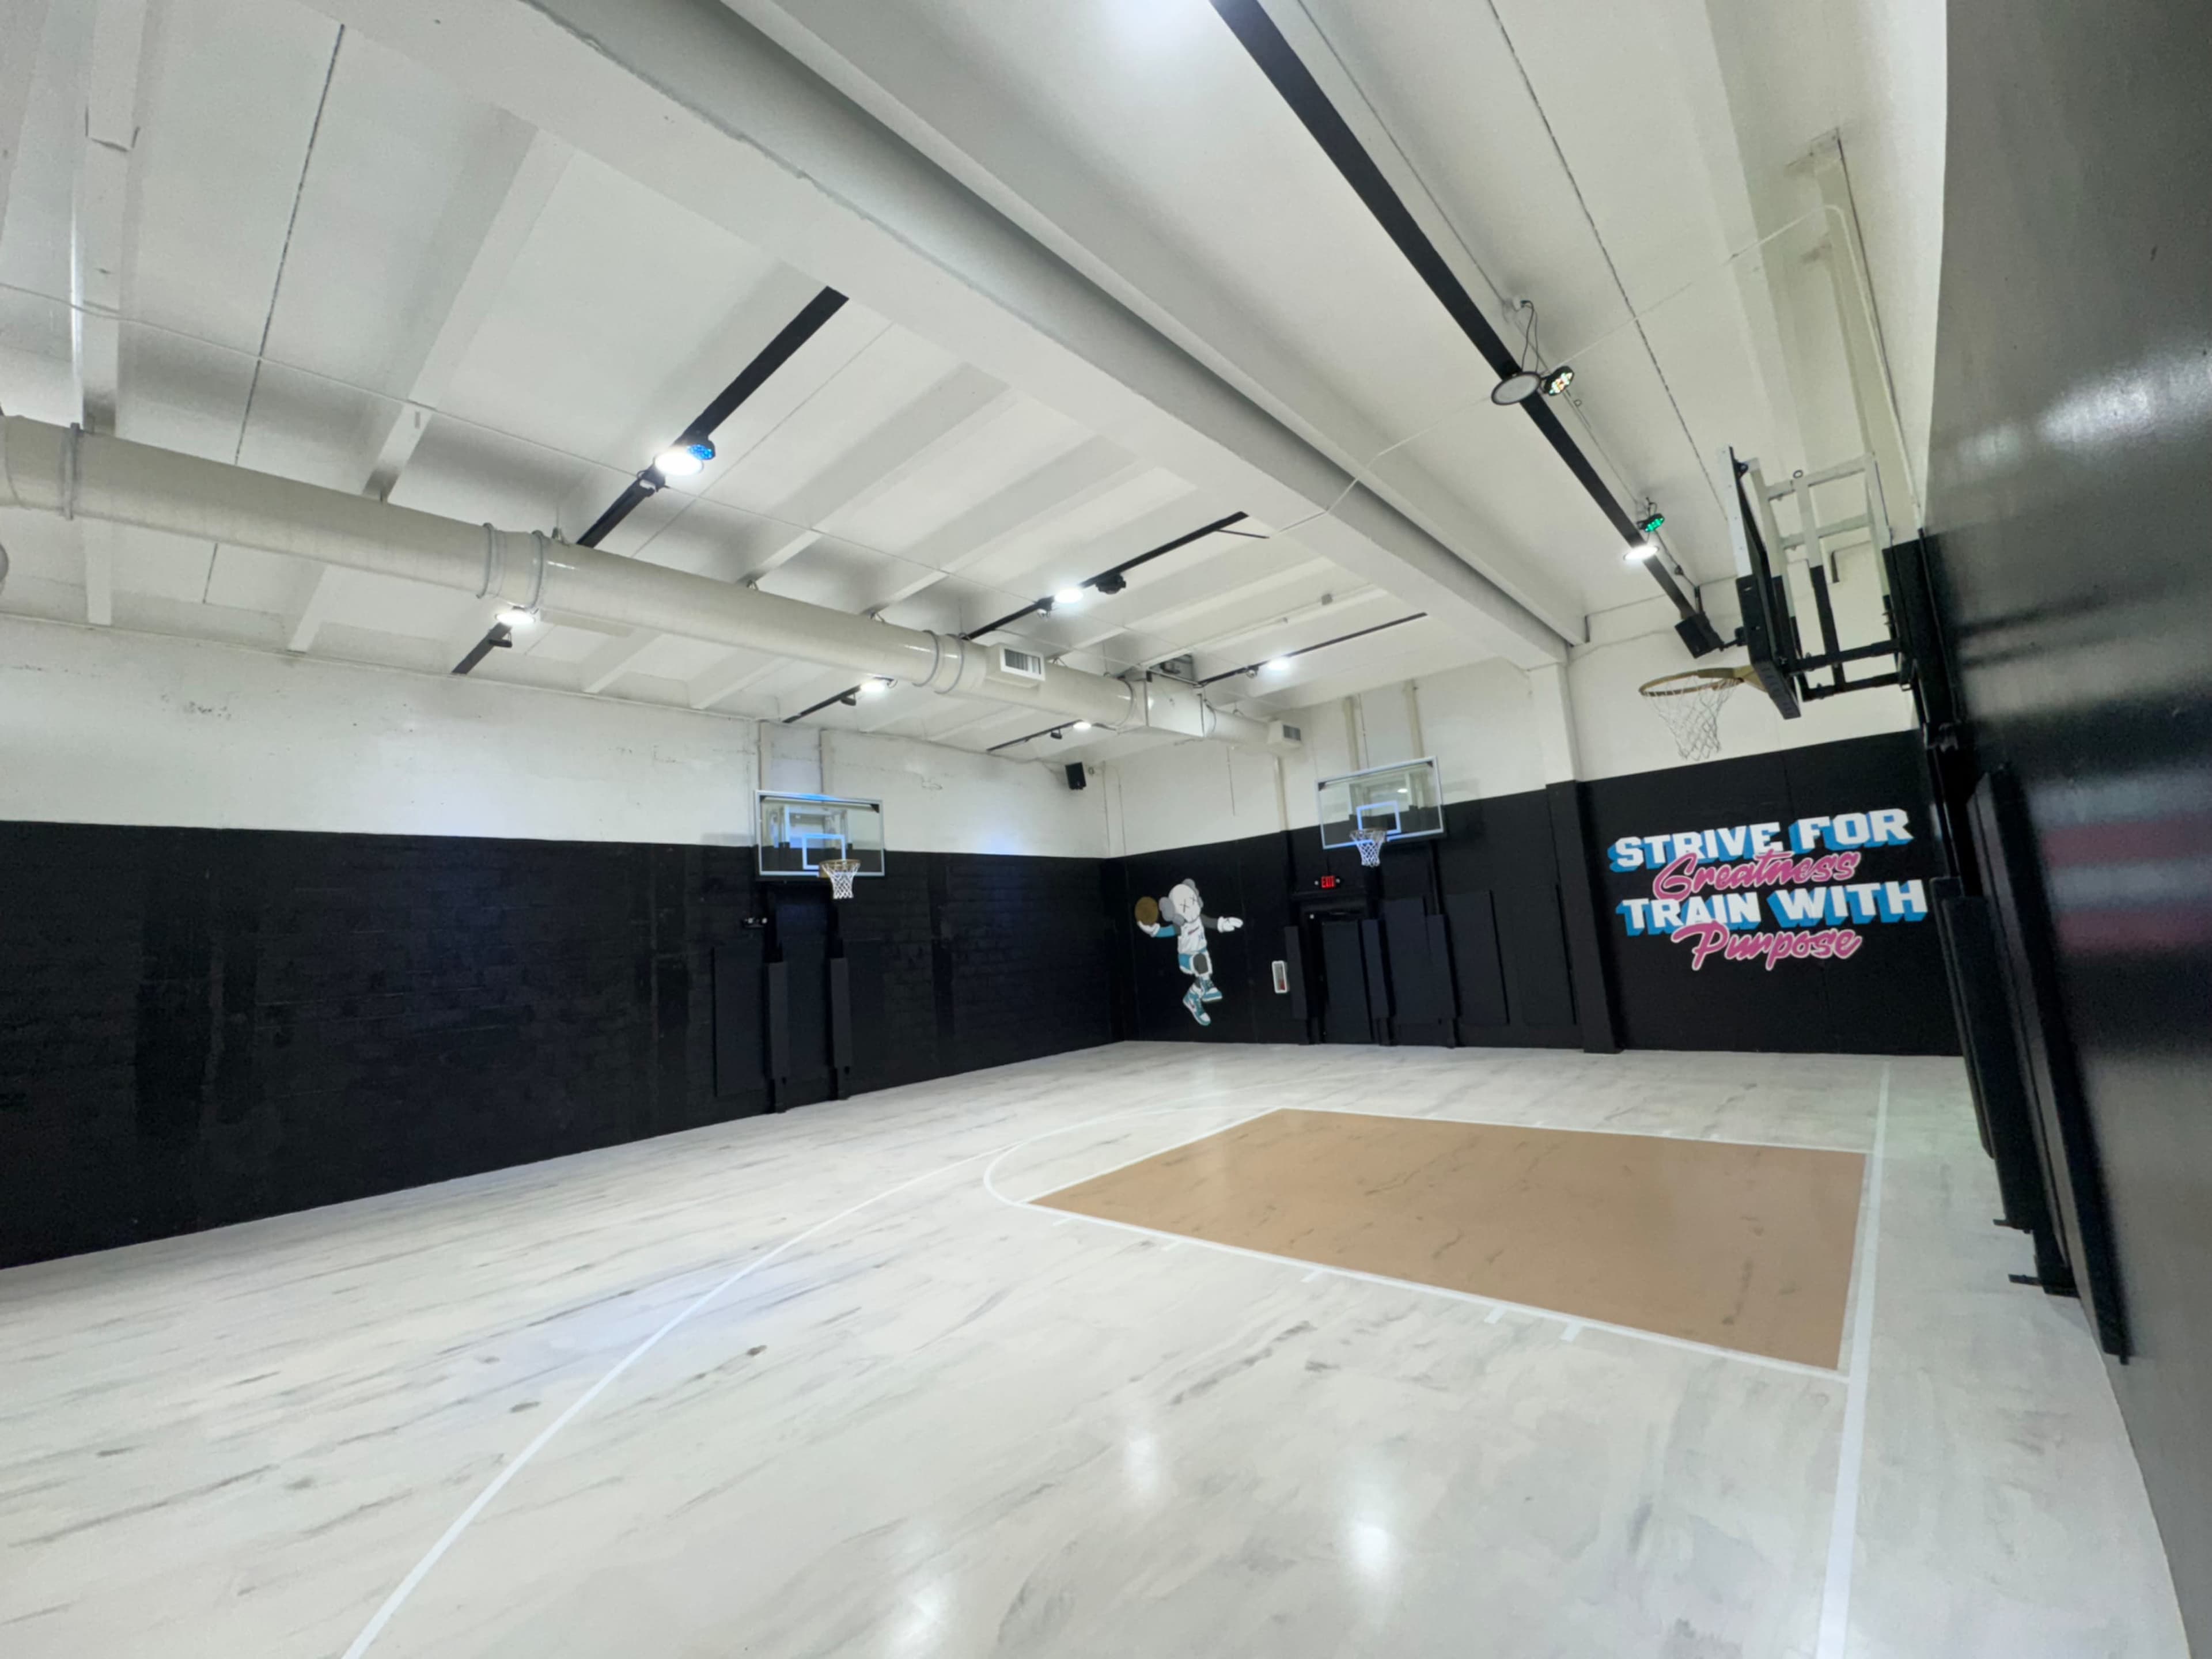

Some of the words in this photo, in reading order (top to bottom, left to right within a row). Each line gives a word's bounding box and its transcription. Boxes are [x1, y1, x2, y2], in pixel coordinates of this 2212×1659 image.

[1607, 822, 1784, 872] STRIVE
[1789, 808, 1913, 854] FOR
[1321, 876, 1335, 888] EXIT
[1653, 849, 1860, 901] Greatness
[1616, 892, 1761, 936] TRAIN
[1767, 880, 1928, 931] WITH
[1671, 920, 1862, 971] Purpose
